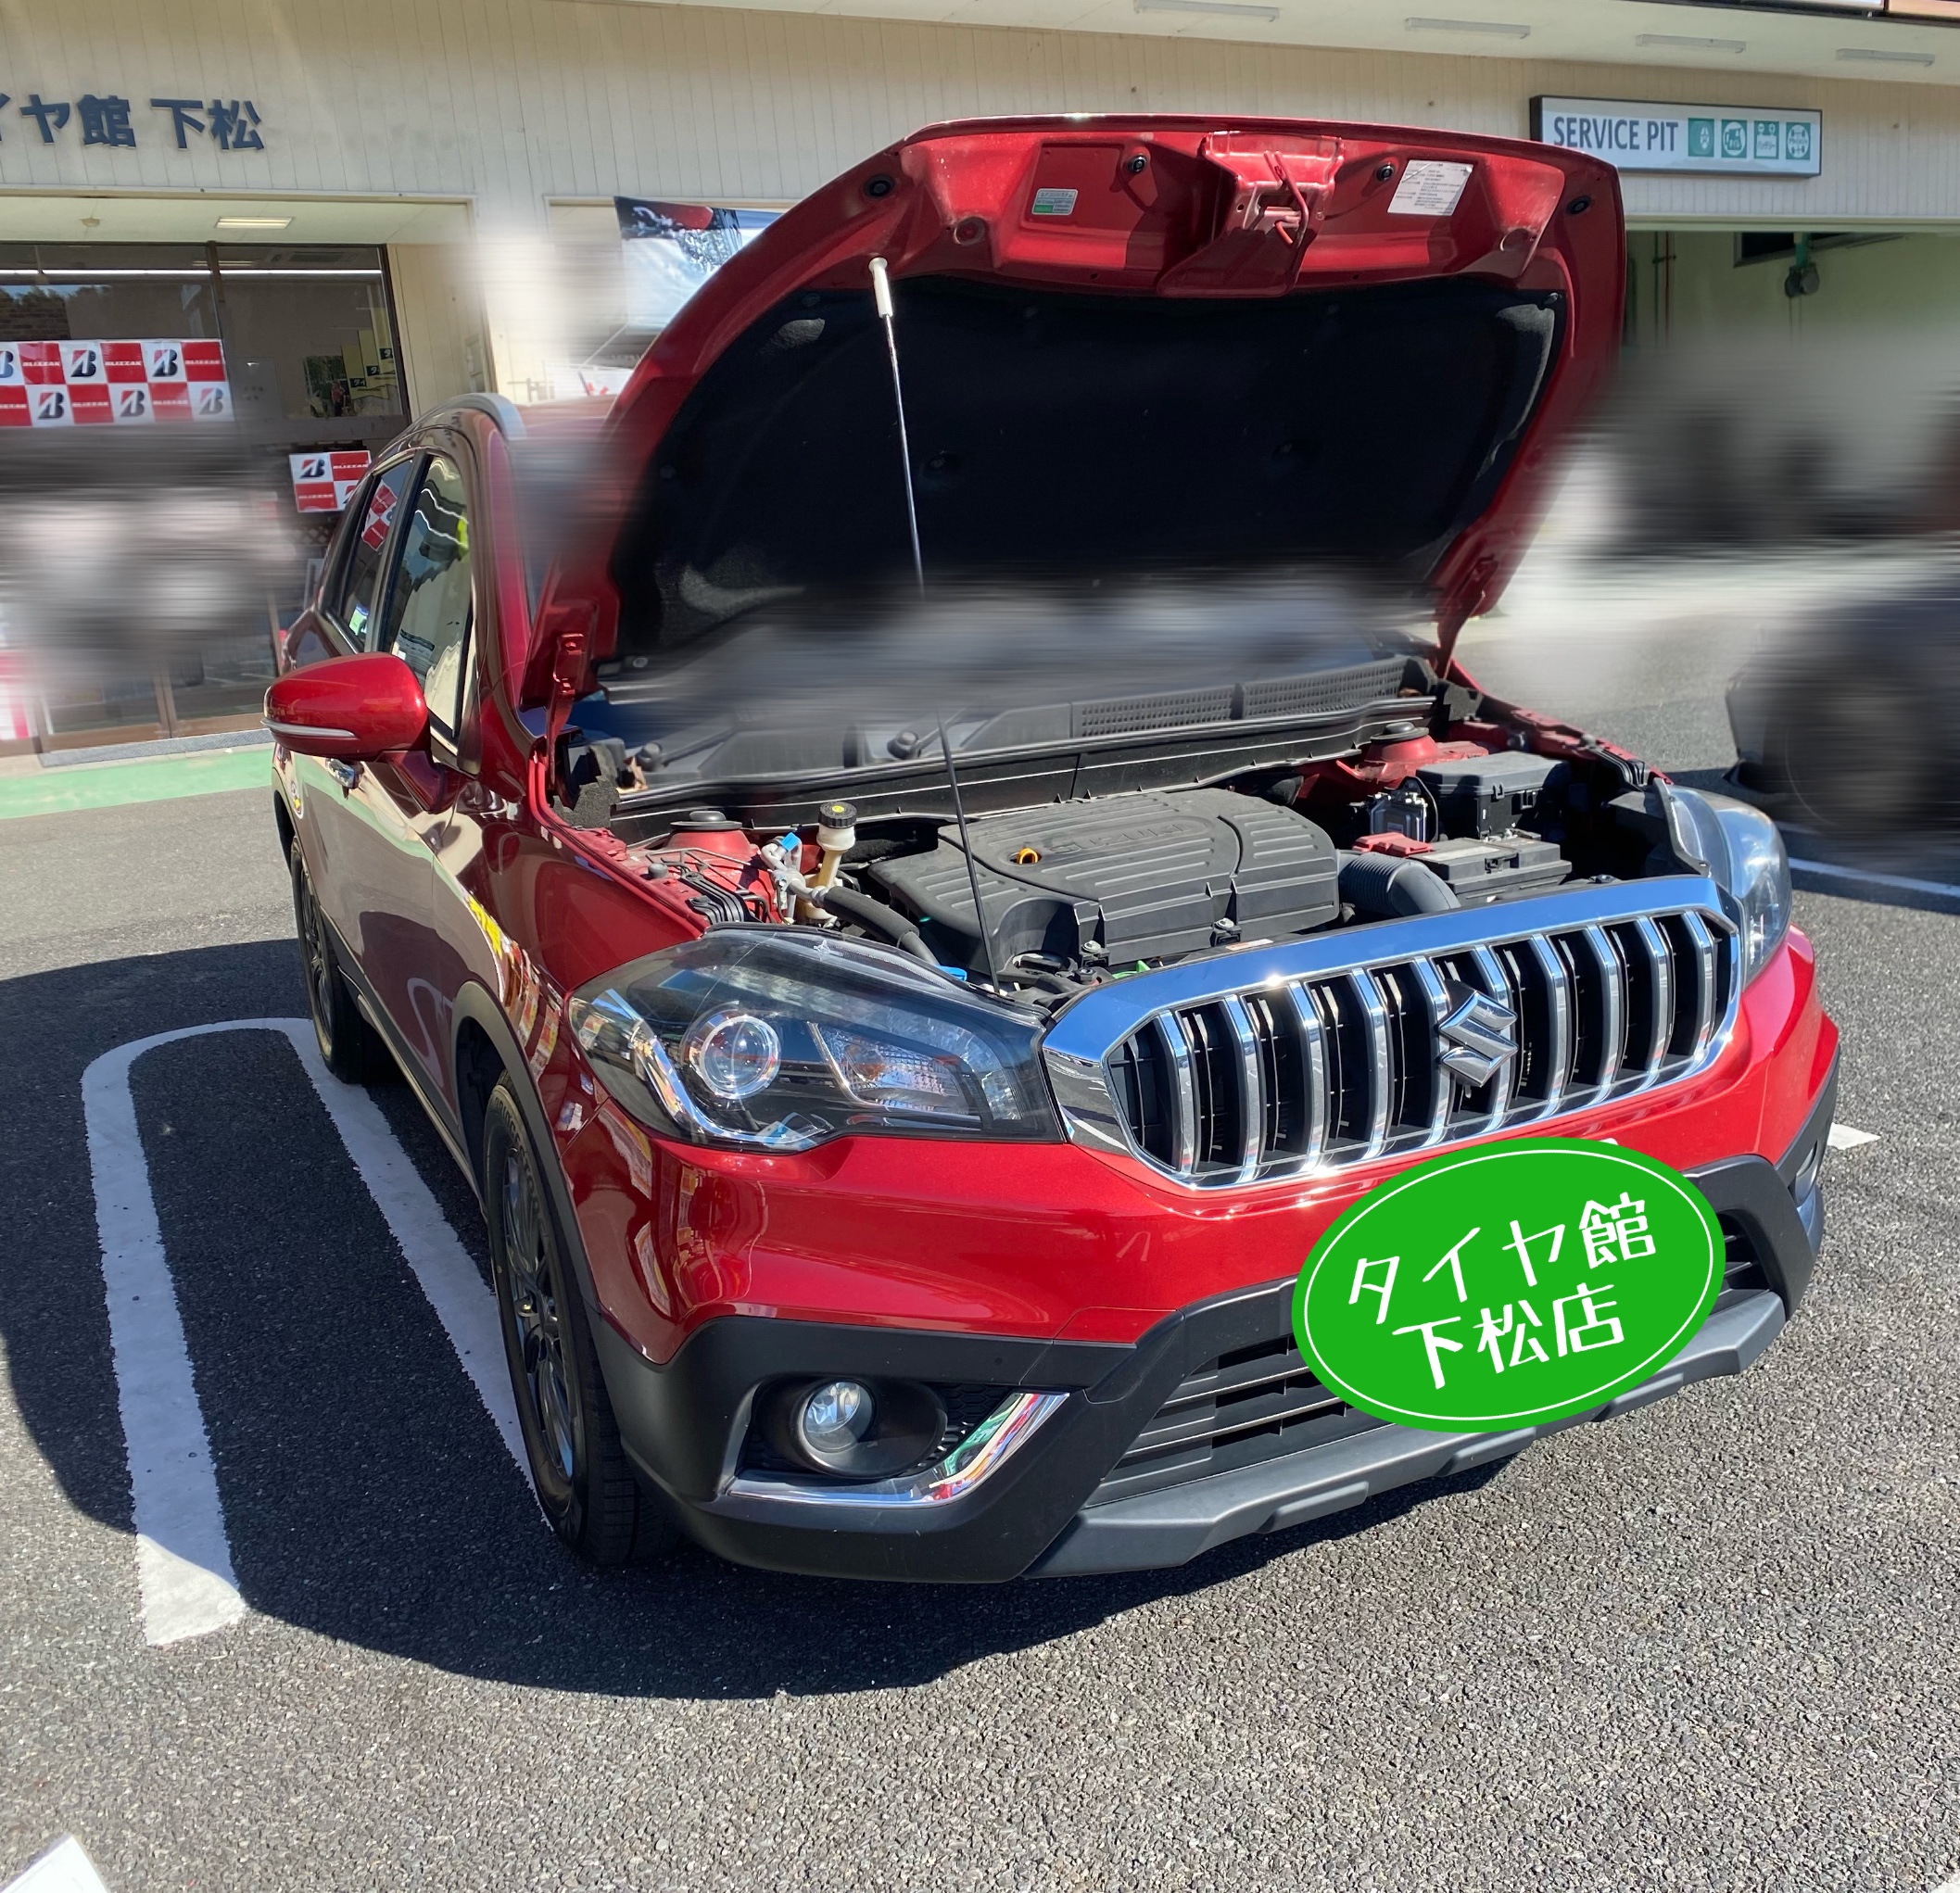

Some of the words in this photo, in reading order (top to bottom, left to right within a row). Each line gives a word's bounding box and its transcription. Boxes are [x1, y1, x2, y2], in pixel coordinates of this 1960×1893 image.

[150, 98, 265, 151] 下松
[1553, 116, 1640, 150] SERVICE
[1647, 120, 1679, 152] PIT
